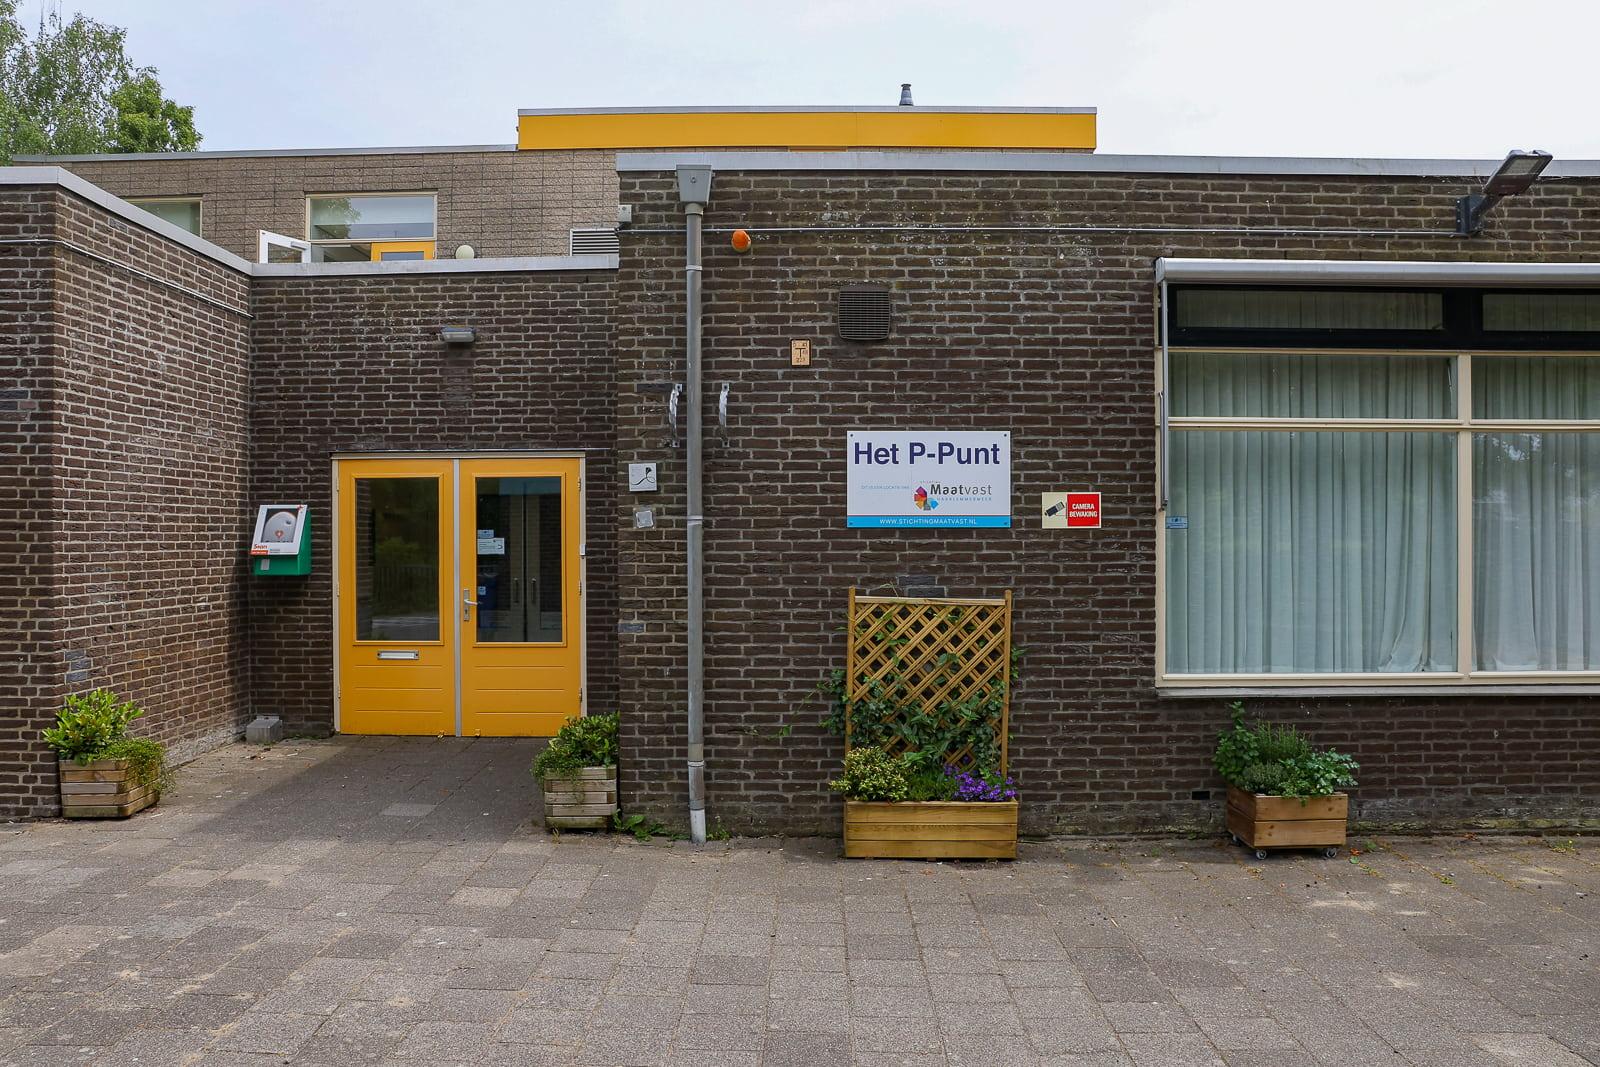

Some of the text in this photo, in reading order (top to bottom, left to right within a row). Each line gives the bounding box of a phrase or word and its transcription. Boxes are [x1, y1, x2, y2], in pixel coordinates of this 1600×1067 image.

[854, 442, 1000, 465] Het P-Punt
[930, 484, 992, 496] Maatvast
[1069, 510, 1098, 518] BEWAKING
